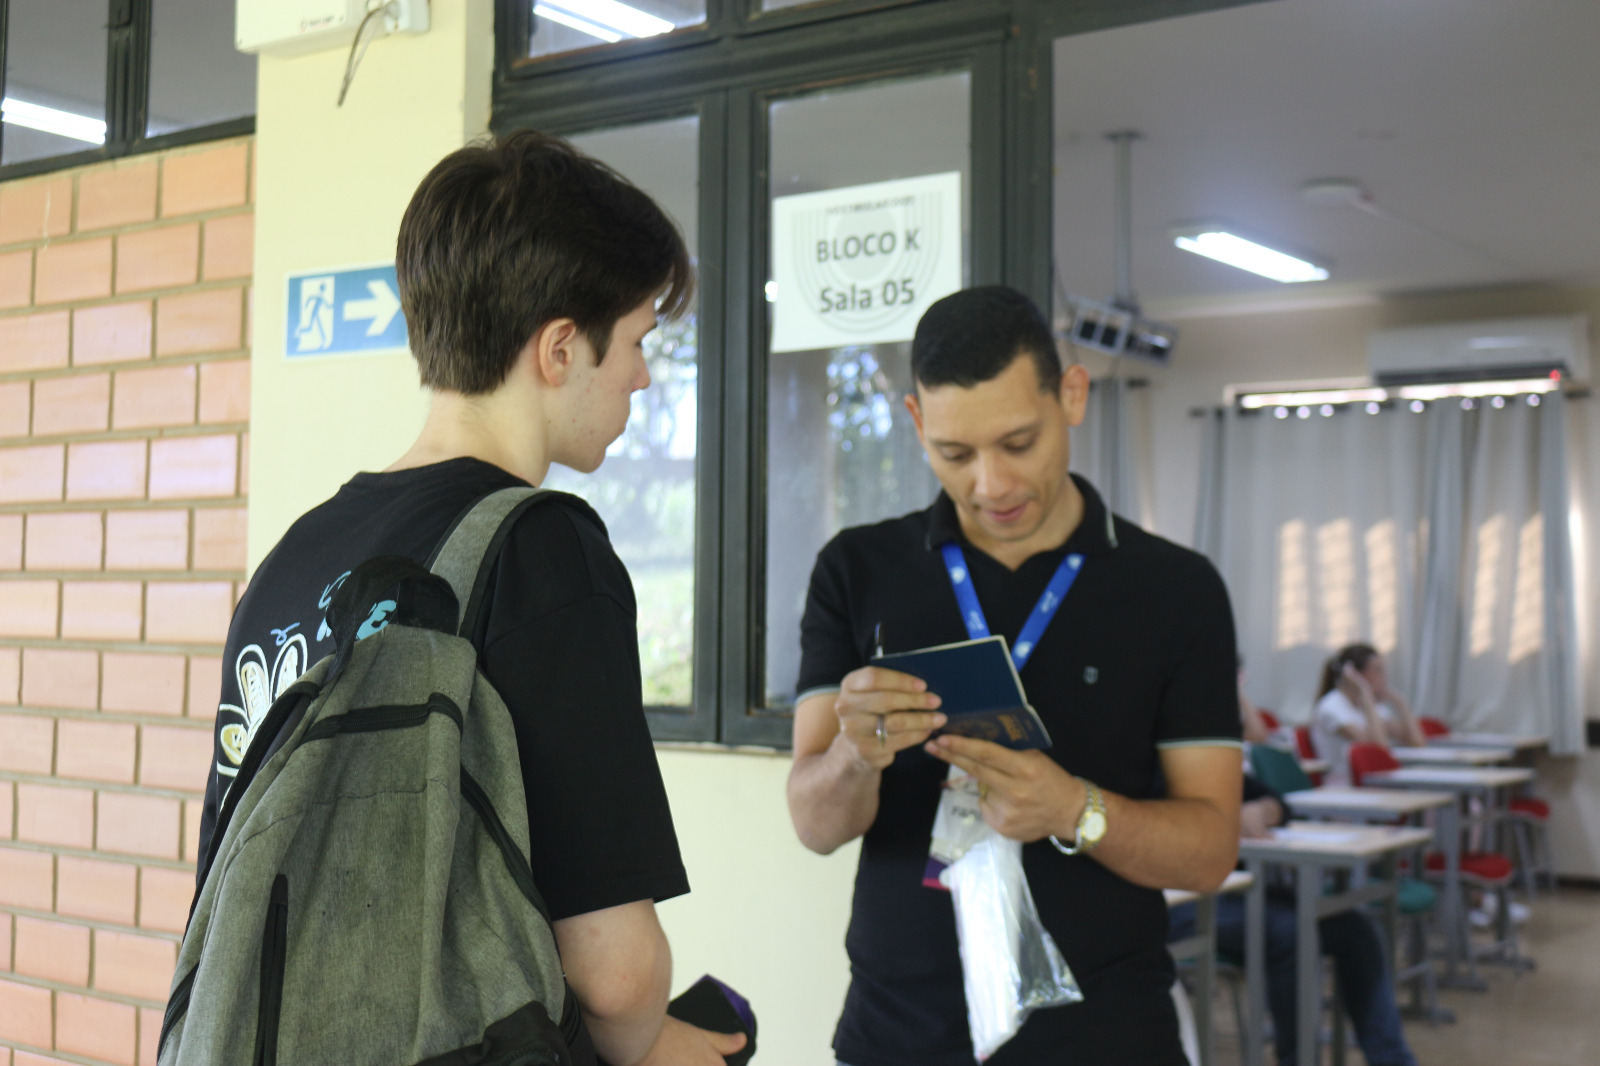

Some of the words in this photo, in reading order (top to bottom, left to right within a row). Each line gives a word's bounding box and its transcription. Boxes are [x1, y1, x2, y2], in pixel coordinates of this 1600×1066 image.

[816, 232, 897, 263] BLOCO
[905, 228, 921, 251] K
[820, 283, 873, 313] Sala
[881, 279, 915, 306] 05
